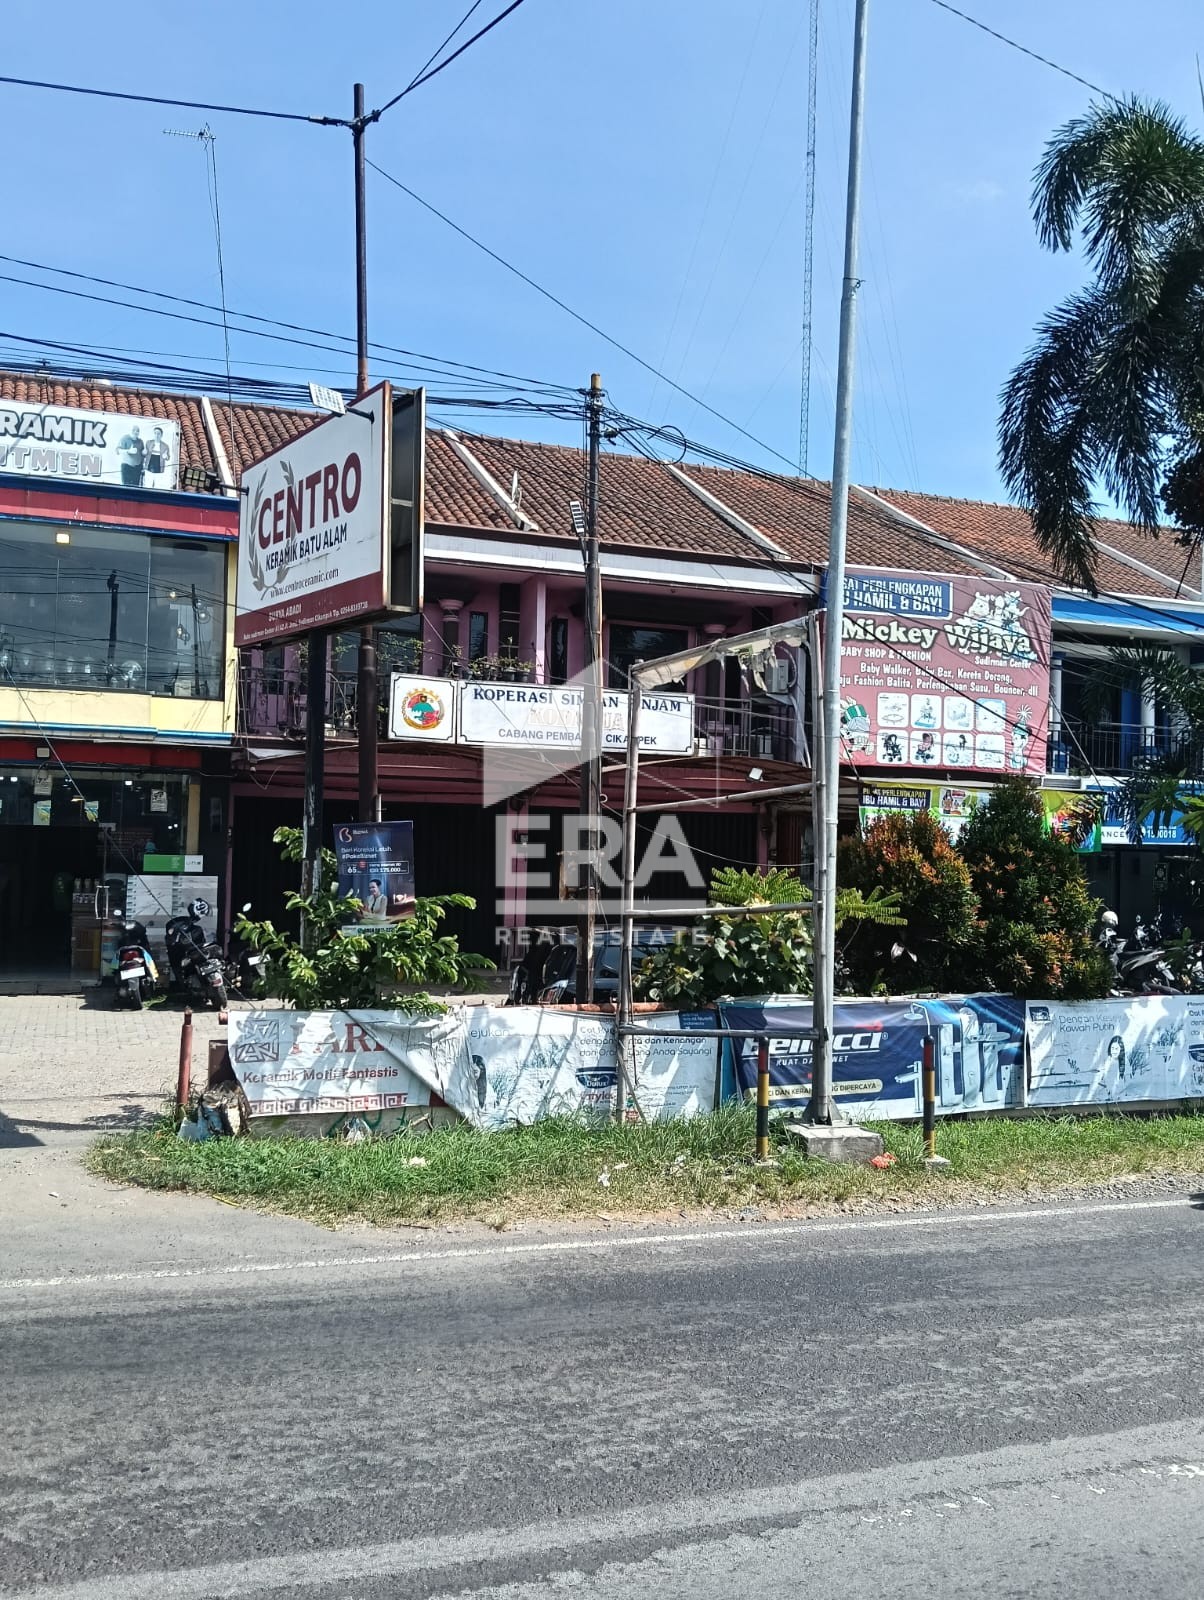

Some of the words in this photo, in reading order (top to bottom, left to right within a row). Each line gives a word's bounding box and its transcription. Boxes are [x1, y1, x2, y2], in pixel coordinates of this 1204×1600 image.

[259, 452, 361, 549] CENTRO
[265, 543, 298, 572] KERAMIK
[300, 533, 322, 559] BATU
[323, 522, 348, 549] ALAM
[270, 568, 339, 598] www.centroceramic.com
[843, 578, 858, 590] SAT
[862, 580, 942, 598] PERLENGKAPAN
[853, 591, 896, 609] HAMIL
[900, 596, 909, 610] &
[913, 596, 942, 613] BAYI
[842, 617, 938, 649] Mickey
[944, 623, 1030, 656] Wijaya
[840, 646, 862, 657] BABY
[864, 647, 887, 658] SHOP
[888, 649, 895, 658] &
[897, 649, 932, 662] FASHION
[974, 656, 1007, 666] Sudirman
[1009, 658, 1031, 669] Center
[860, 663, 880, 676] Baby
[882, 664, 912, 677] Walker,
[915, 666, 935, 679] Baby
[957, 668, 983, 680] Kereta
[854, 676, 884, 687] Fashion
[886, 677, 913, 689] Balita,
[970, 682, 991, 694] Susu,
[1028, 685, 1039, 697] dll
[473, 688, 553, 704] KOPERASI
[561, 691, 619, 708] SIMAN
[641, 698, 681, 713] NJAM
[498, 728, 545, 741] CABANG
[546, 729, 582, 742] PEMBA
[605, 733, 657, 746] CIKAPEK
[862, 795, 876, 805] IBU
[877, 796, 901, 806] HAMIL
[909, 798, 926, 807] BAYI
[882, 788, 927, 798] PERLENGKAPAN
[470, 1027, 510, 1039] ejukan
[1059, 1023, 1090, 1033] Kawah
[1092, 1022, 1115, 1031] Putih
[645, 1037, 661, 1045] dan
[663, 1036, 706, 1046] Kenangan
[653, 1048, 675, 1056] Anda
[678, 1046, 712, 1057] Sayangi
[776, 1058, 799, 1067] KUAT
[803, 1057, 813, 1065] DA
[832, 1055, 849, 1063] WET
[243, 1071, 298, 1083] Keramik
[342, 1066, 398, 1079] Fantastis
[775, 1087, 790, 1097] DAN
[840, 1082, 877, 1092] DIPERCAYA
